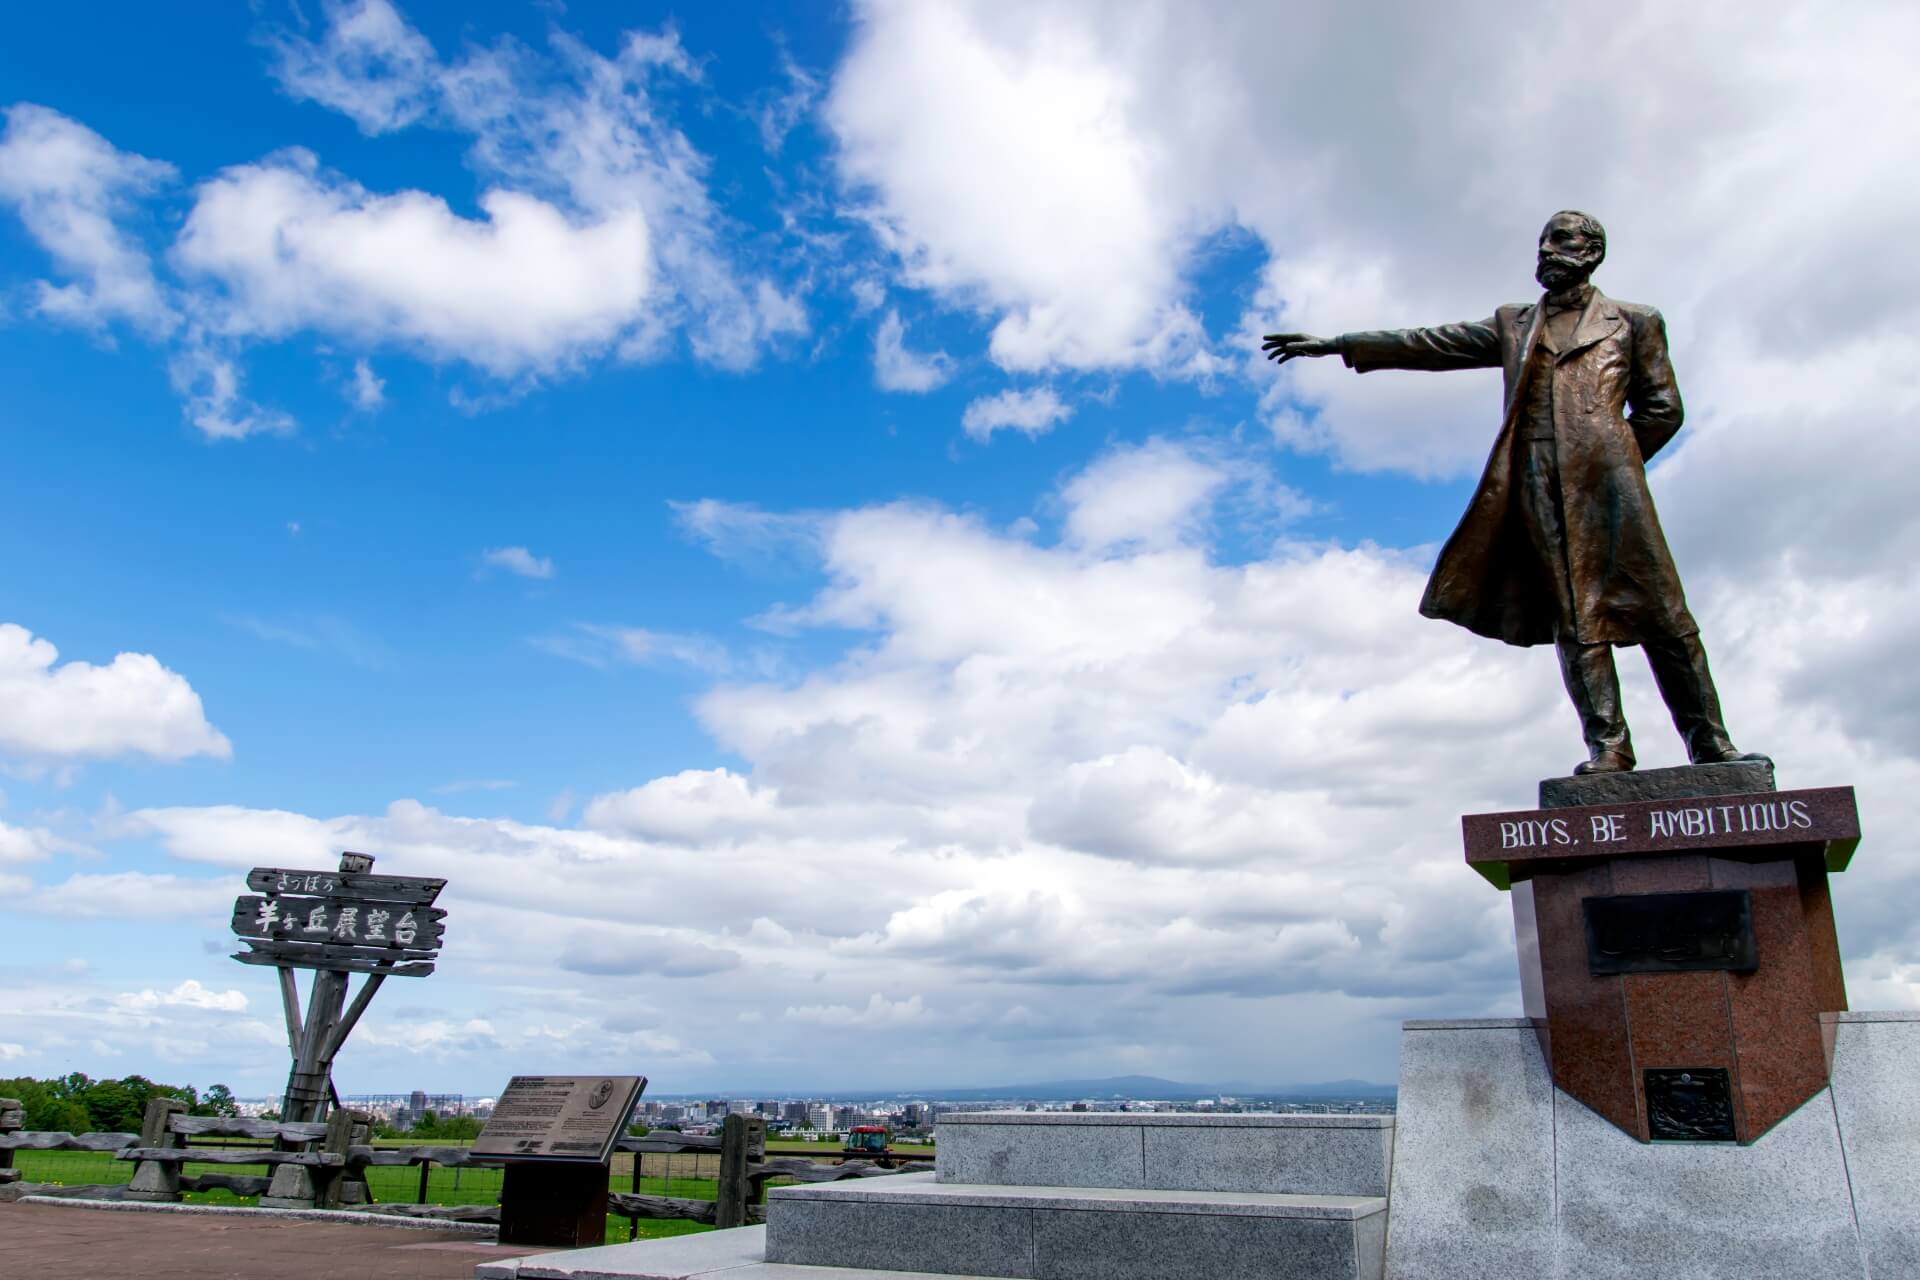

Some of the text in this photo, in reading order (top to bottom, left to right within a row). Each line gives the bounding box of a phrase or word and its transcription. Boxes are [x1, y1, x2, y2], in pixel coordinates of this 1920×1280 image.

[1500, 800, 1812, 848] BOYS, BE AMBITIOUS
